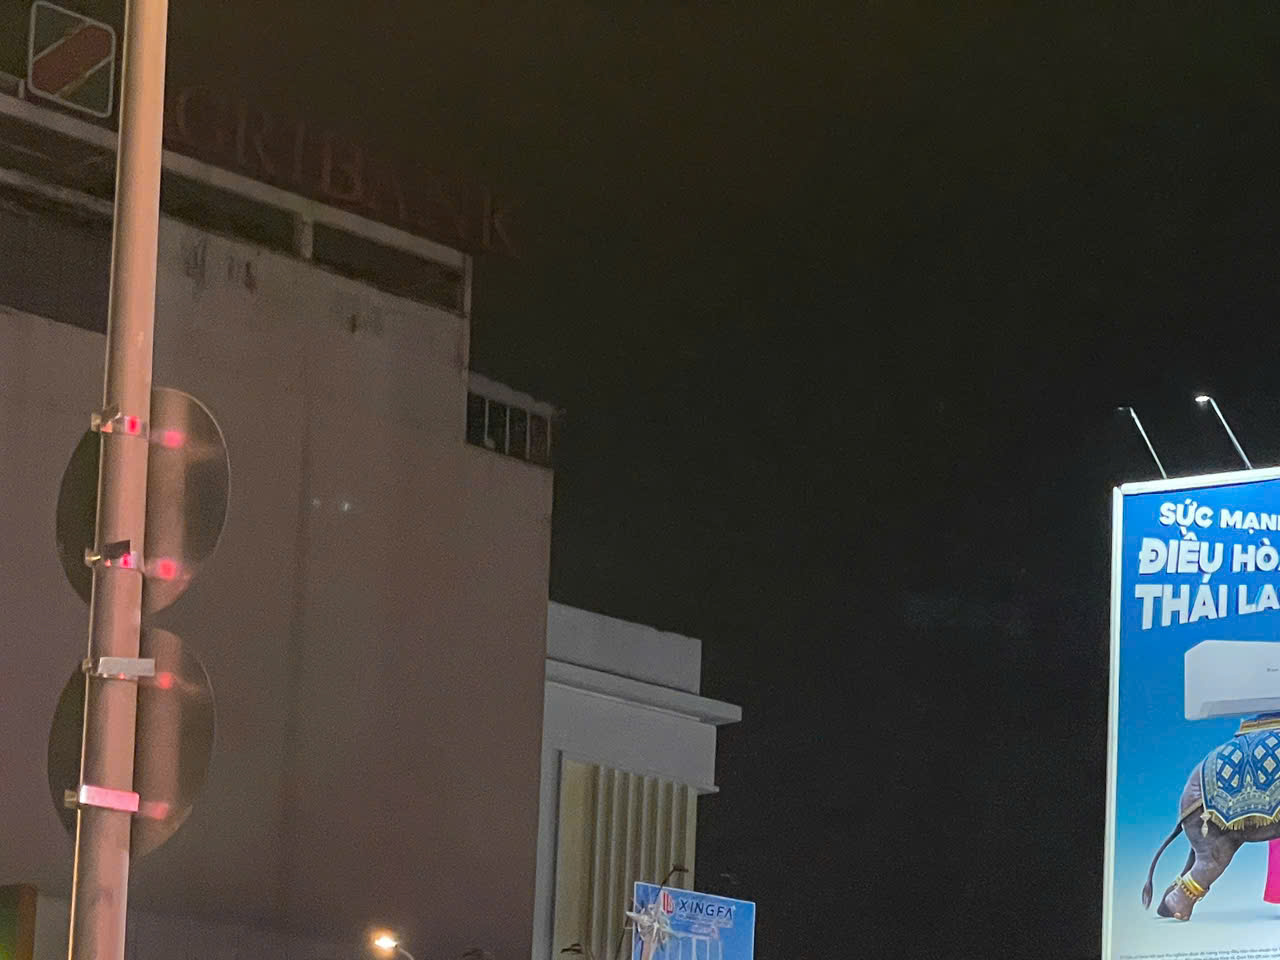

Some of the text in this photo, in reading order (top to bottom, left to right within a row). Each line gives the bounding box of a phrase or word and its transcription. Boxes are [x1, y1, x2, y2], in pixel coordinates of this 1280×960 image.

[1159, 498, 1214, 529] SỨC
[1138, 526, 1224, 575] ĐIỀU
[1135, 573, 1229, 630] THÁI
[678, 899, 733, 920] XINGFA
